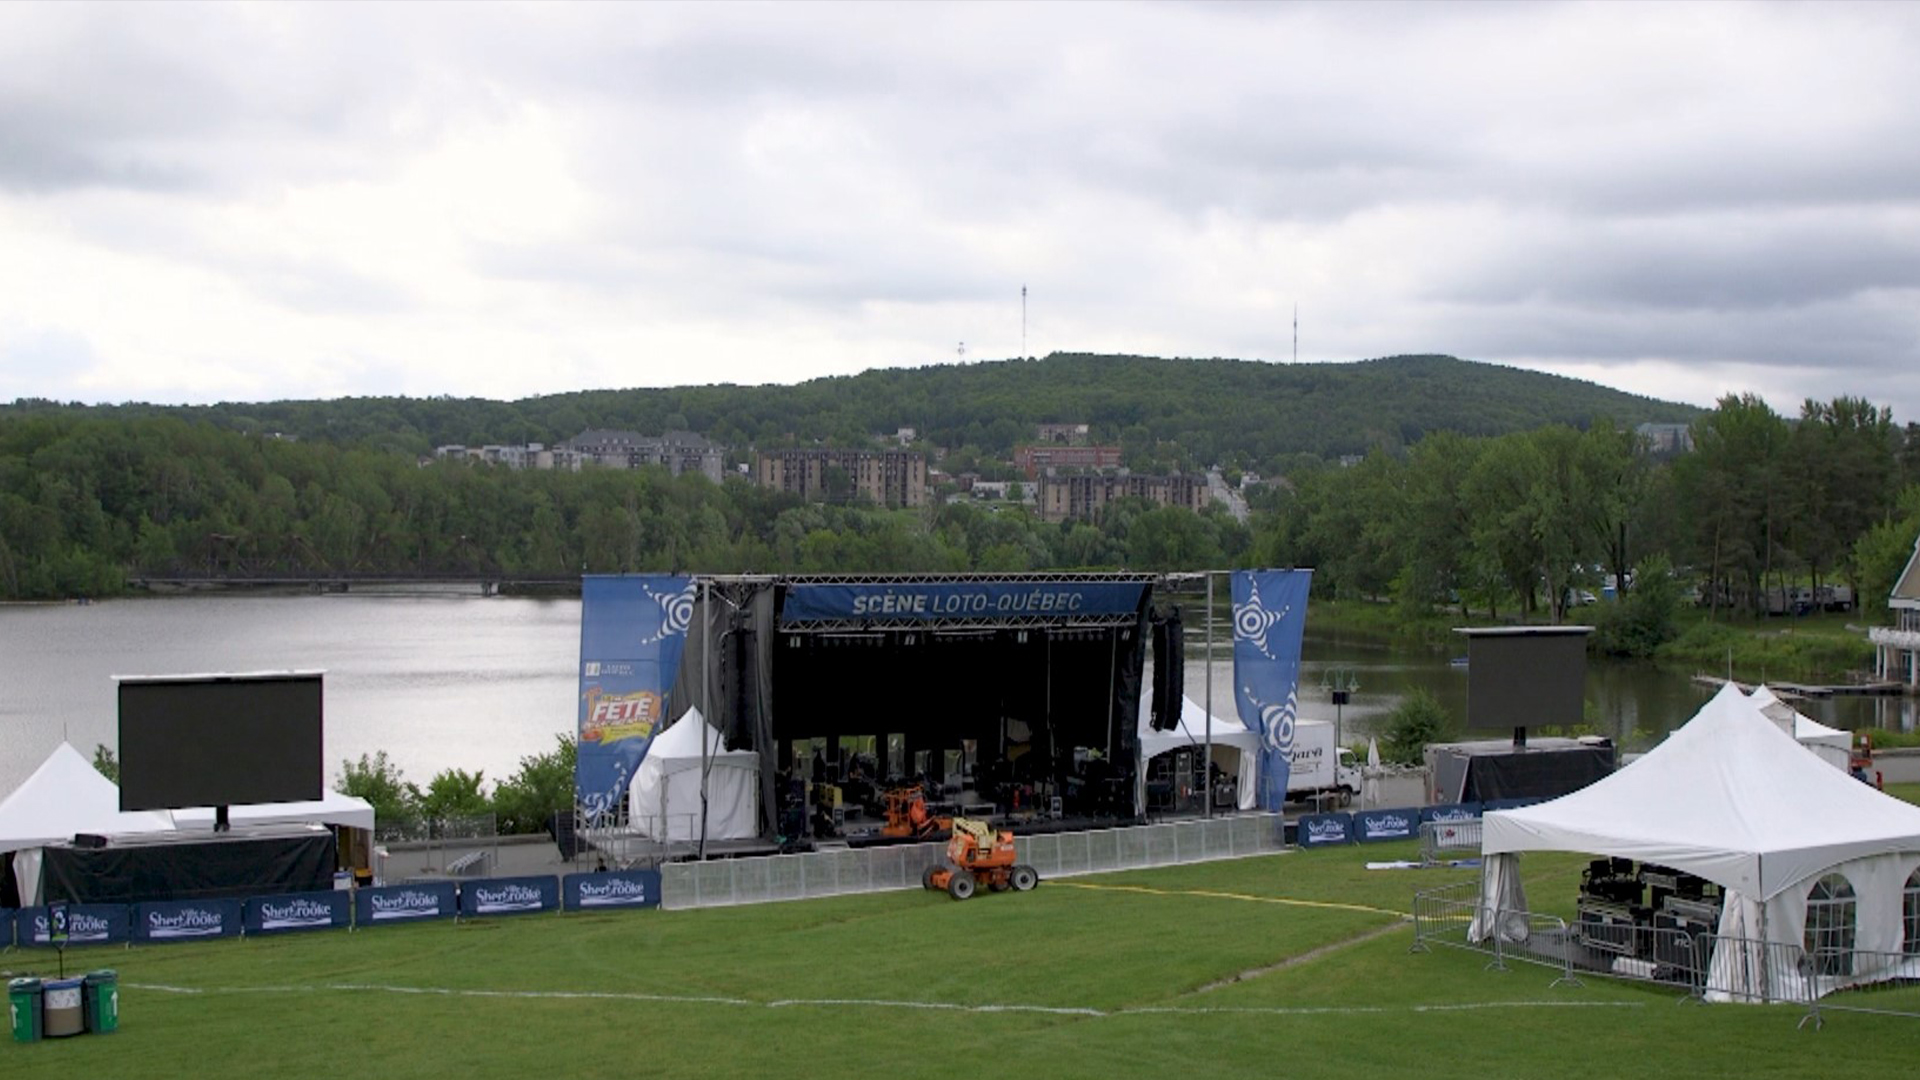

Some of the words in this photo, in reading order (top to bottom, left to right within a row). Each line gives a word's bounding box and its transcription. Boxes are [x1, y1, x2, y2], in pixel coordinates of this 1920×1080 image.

[852, 589, 927, 615] SCÈNE
[932, 588, 1083, 613] LOTO-QUÉBEC
[592, 697, 653, 721] FÊTE
[476, 887, 542, 902] Sherbrooke
[579, 881, 644, 896] Sherbrooke
[371, 894, 438, 909] Sherbrooke
[261, 902, 331, 918] Sherbrooke
[149, 911, 222, 927] Sherbrooke
